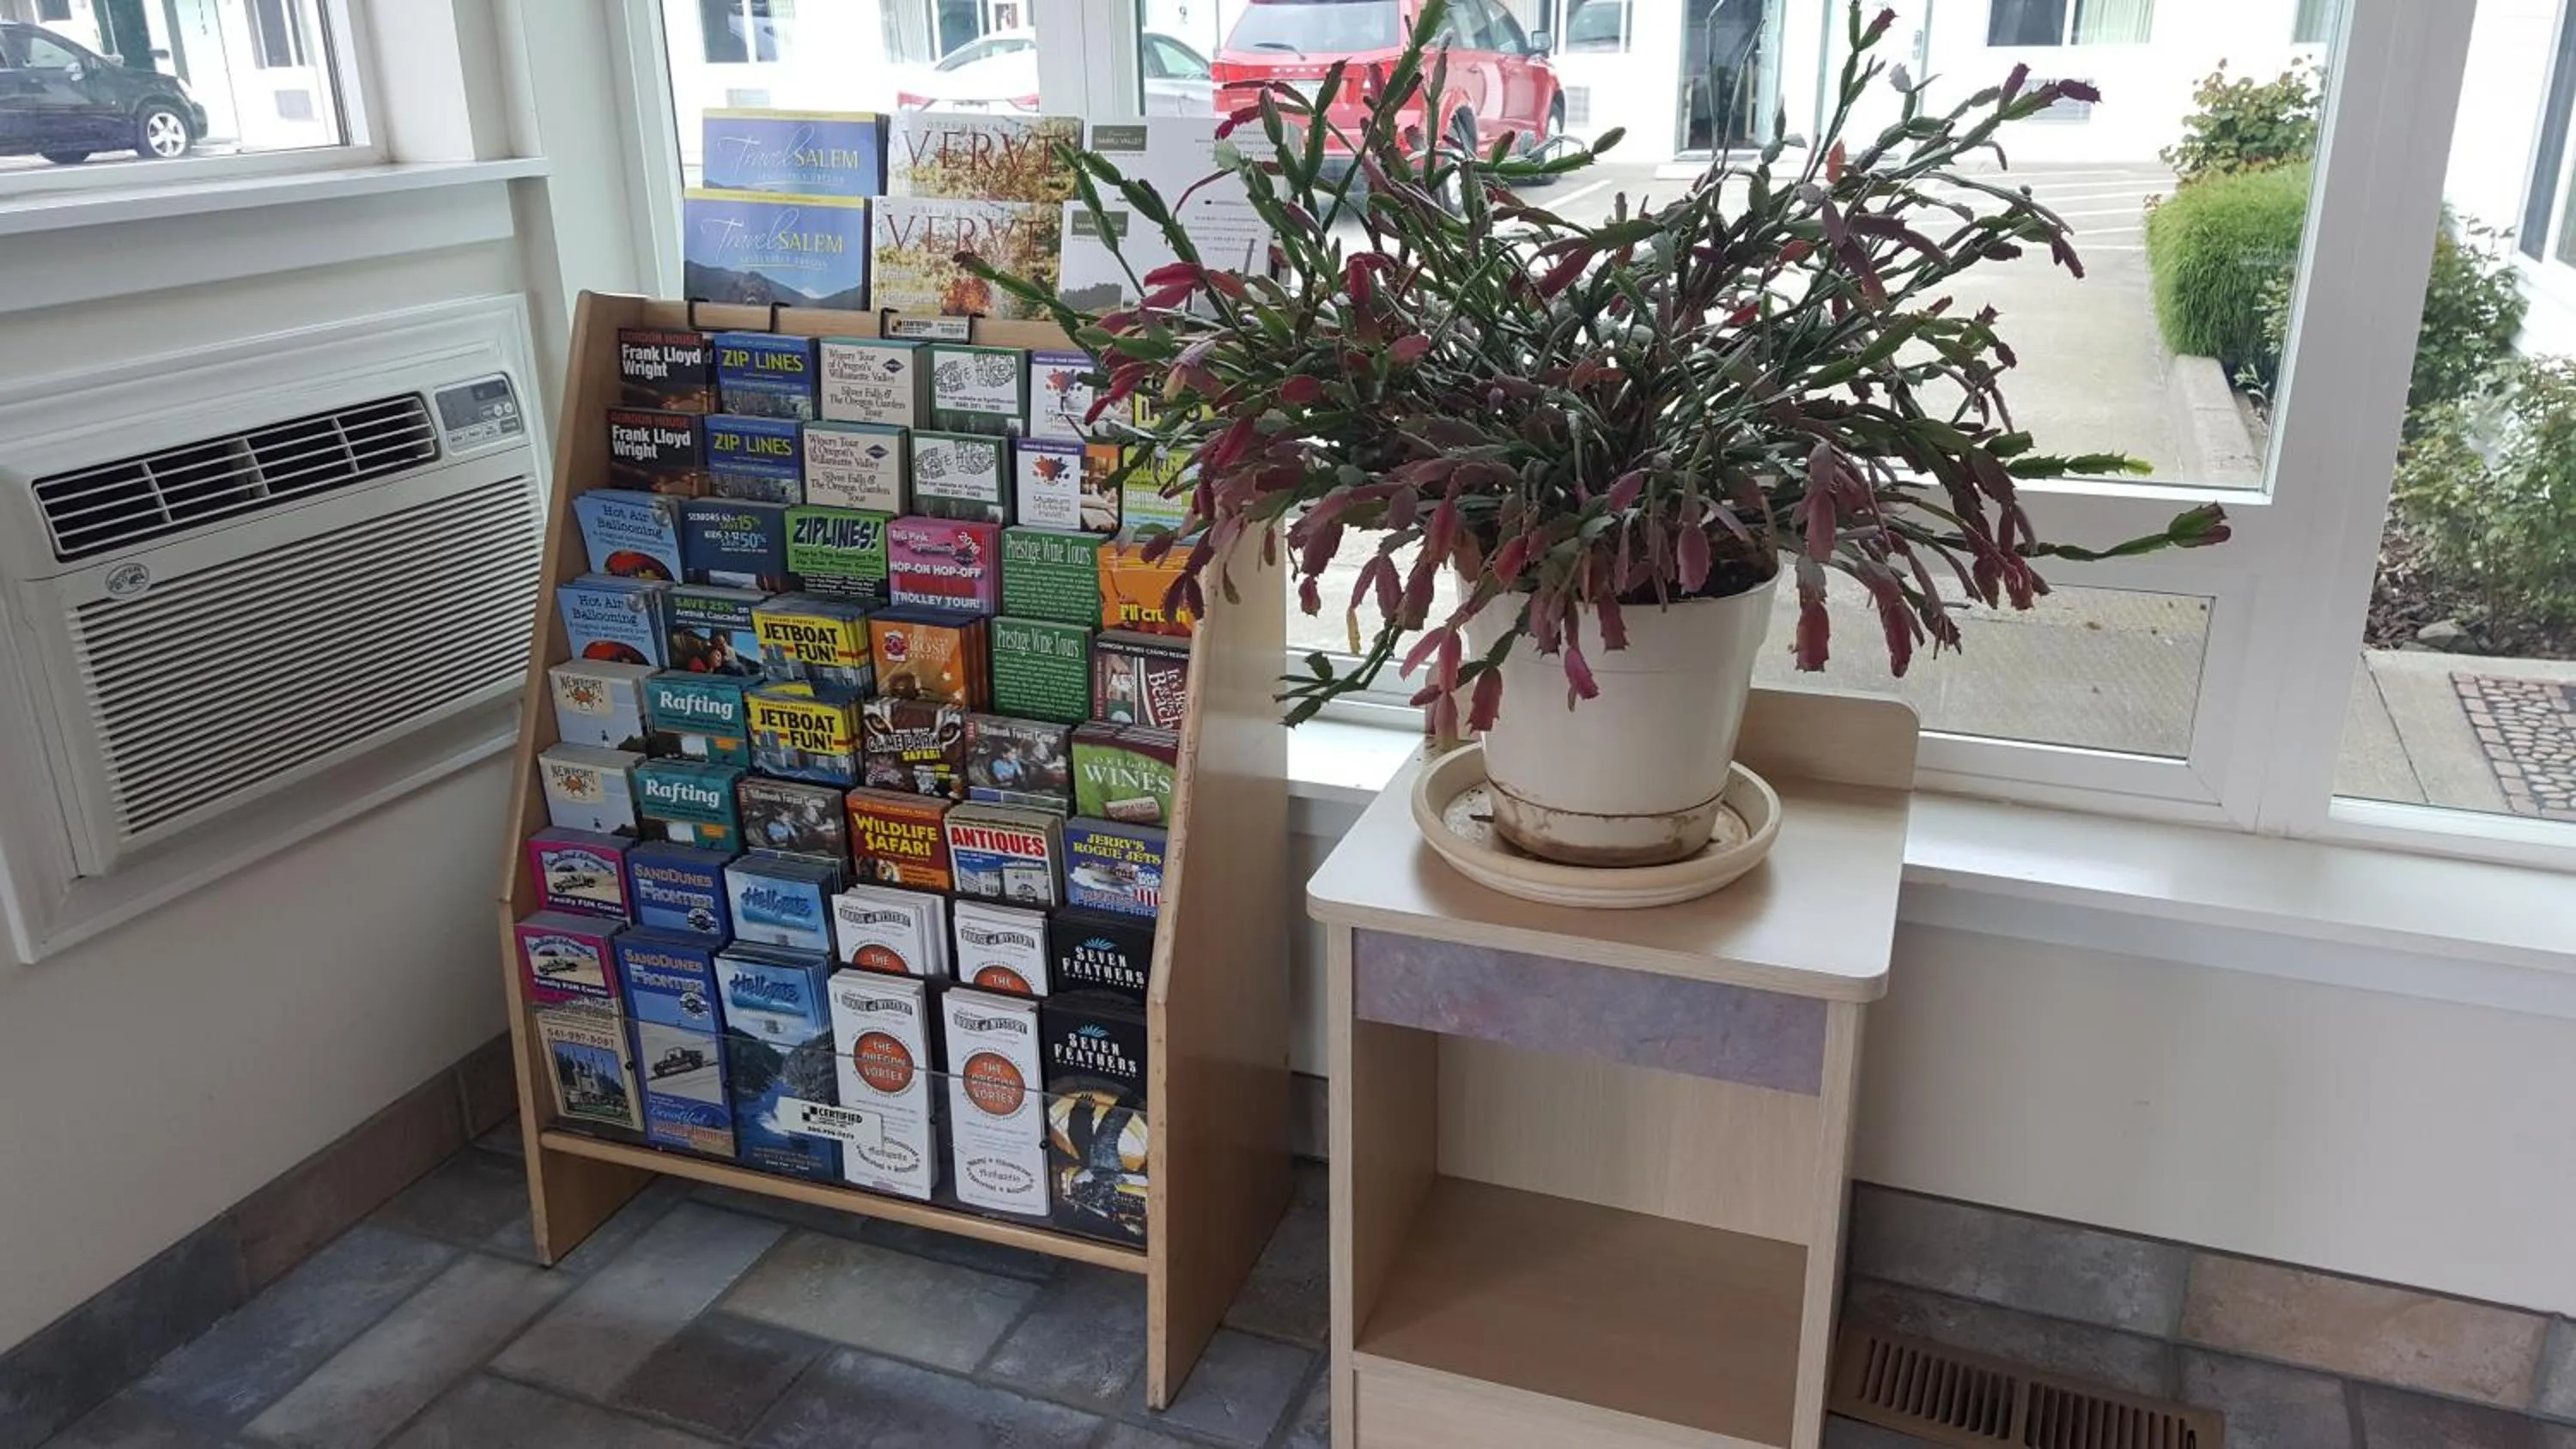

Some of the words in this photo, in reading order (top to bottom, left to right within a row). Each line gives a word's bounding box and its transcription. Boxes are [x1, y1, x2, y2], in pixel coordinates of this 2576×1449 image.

[795, 149, 859, 169] SALEM
[902, 130, 1065, 177] VERVE
[778, 232, 845, 254] SALEM
[885, 214, 1047, 263] VERVE
[622, 344, 660, 361] Frank
[665, 347, 702, 367] Lloyd
[721, 349, 749, 367] ZIP
[755, 352, 804, 372] LINES
[623, 361, 668, 379] Wright
[612, 426, 649, 441] Frank
[654, 427, 691, 449] Lloyd
[714, 433, 740, 450] ZIP
[745, 434, 793, 456] LINES
[613, 441, 658, 459] Wright
[604, 505, 624, 518] Hot
[630, 510, 649, 522] Air
[597, 517, 664, 540] Ballooning
[793, 516, 882, 551] ZIPLINES!
[1005, 533, 1041, 565] Prestige
[1042, 537, 1064, 562] Wine
[1066, 539, 1091, 565] Tours
[933, 565, 982, 578] HOP-OFF
[578, 595, 600, 607] Hot
[605, 597, 624, 608] Air
[894, 591, 942, 605] TROLLEY
[945, 597, 981, 609] TOUR!
[572, 608, 638, 626] Ballooning
[764, 622, 838, 645] JETBOAT
[996, 624, 1030, 656] Prestige
[1031, 627, 1054, 654] Wine
[1054, 631, 1079, 658] Tours
[794, 643, 838, 664] FUN!
[659, 690, 733, 719] Rafting
[1147, 669, 1179, 730] Beach
[760, 707, 835, 733] JETBOAT
[789, 731, 835, 751] FUN!
[902, 749, 941, 761] SAFARI
[1083, 762, 1172, 794] WINES
[646, 779, 720, 808] Rafting
[854, 811, 939, 842] WILDLIFE
[865, 831, 933, 858] SAFARI
[950, 826, 1046, 858] ANTIQUES
[1072, 840, 1122, 859] ROGUE
[1126, 851, 1162, 865] JETS
[1087, 834, 1145, 852] JERRY'S
[871, 954, 890, 966] THE
[1075, 945, 1127, 967] SEVEN
[992, 974, 1012, 987] THE
[1062, 957, 1145, 985] FEATHERS
[873, 1040, 893, 1053] THE
[1068, 1033, 1120, 1056] SEVEN
[982, 1062, 1001, 1075] THE
[1054, 1043, 1137, 1074] FEATHERS
[864, 1065, 904, 1082] VORTEX
[972, 1088, 1014, 1105] VORTEX
[818, 1107, 863, 1125] CERTIFIED
